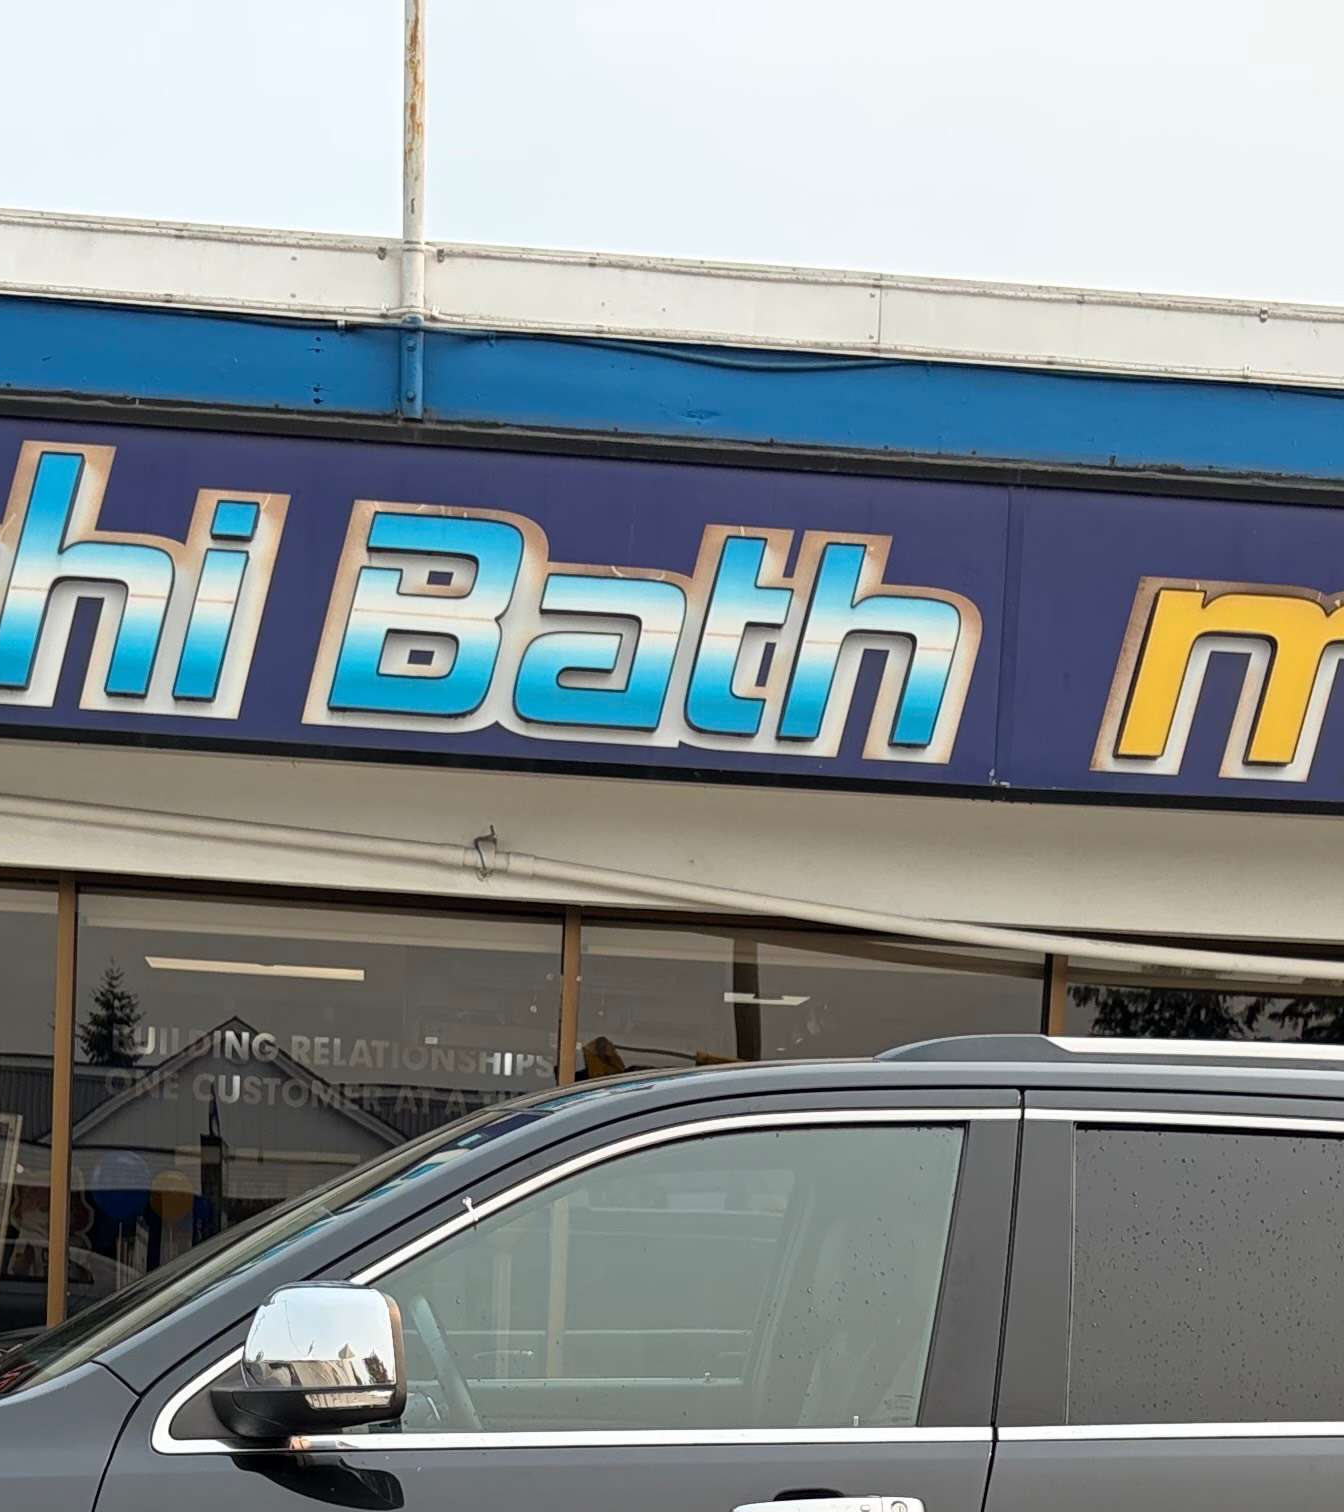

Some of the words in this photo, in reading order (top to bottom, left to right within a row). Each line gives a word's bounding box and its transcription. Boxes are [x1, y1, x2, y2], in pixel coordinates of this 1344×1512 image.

[301, 500, 983, 763] Bath
[112, 1024, 279, 1063] BUILDING
[291, 1035, 554, 1078] RELATIONSHIPS
